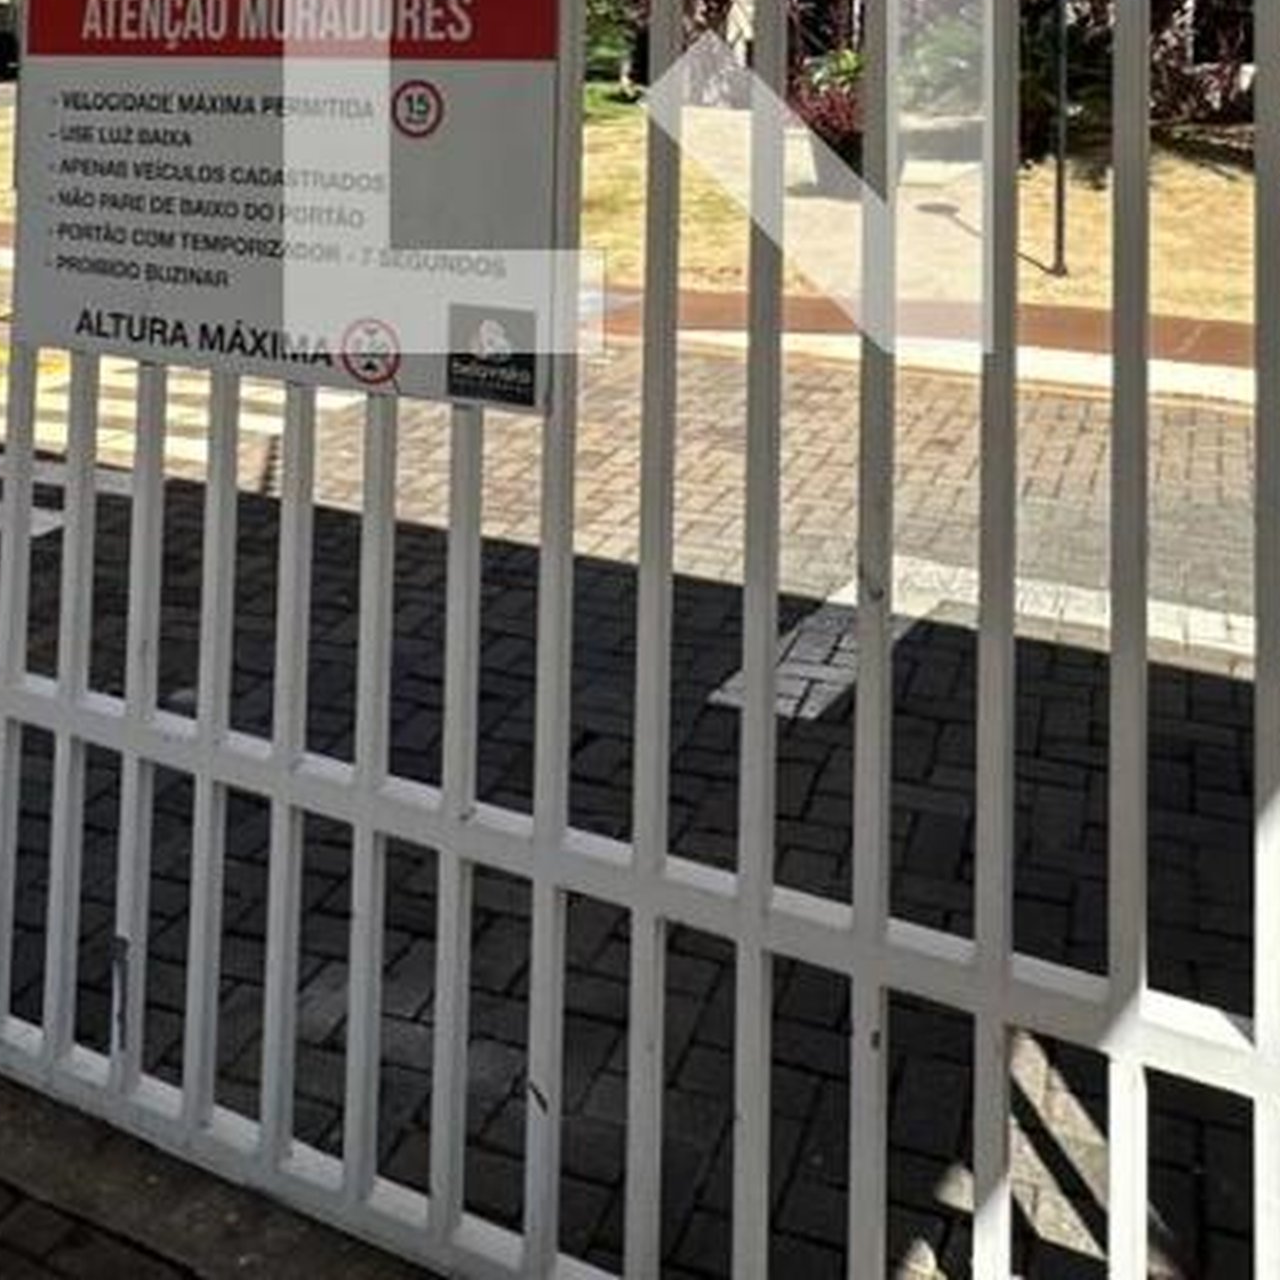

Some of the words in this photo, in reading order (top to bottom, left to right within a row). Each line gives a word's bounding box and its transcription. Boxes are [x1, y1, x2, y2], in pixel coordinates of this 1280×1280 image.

[60, 90, 173, 114] VELOCIDADE
[177, 91, 257, 119] MÁXIMA
[262, 96, 375, 120] PERMITIDA
[60, 126, 94, 144] USE
[99, 128, 134, 145] LUZ
[138, 130, 192, 148] BAIXA
[59, 158, 128, 180] APENAS
[133, 161, 225, 186] VEÍCULOS
[231, 167, 386, 193] CADASTRADOS
[58, 187, 95, 208] NÃO
[100, 192, 146, 213] PARE
[150, 196, 177, 215] DE
[180, 197, 238, 220] BAIXO
[244, 203, 274, 223] DO
[278, 203, 365, 230] PORTÃO
[57, 222, 126, 245] PORTÃO
[131, 228, 175, 250] COM
[181, 233, 341, 266] TEMPORIZADOR
[379, 250, 507, 279] SEGUNDOS
[56, 254, 141, 281] PROIBIDO
[145, 262, 229, 289] BUZINAR
[75, 306, 190, 349] ALTURA
[198, 318, 334, 368] MÁXIMA
